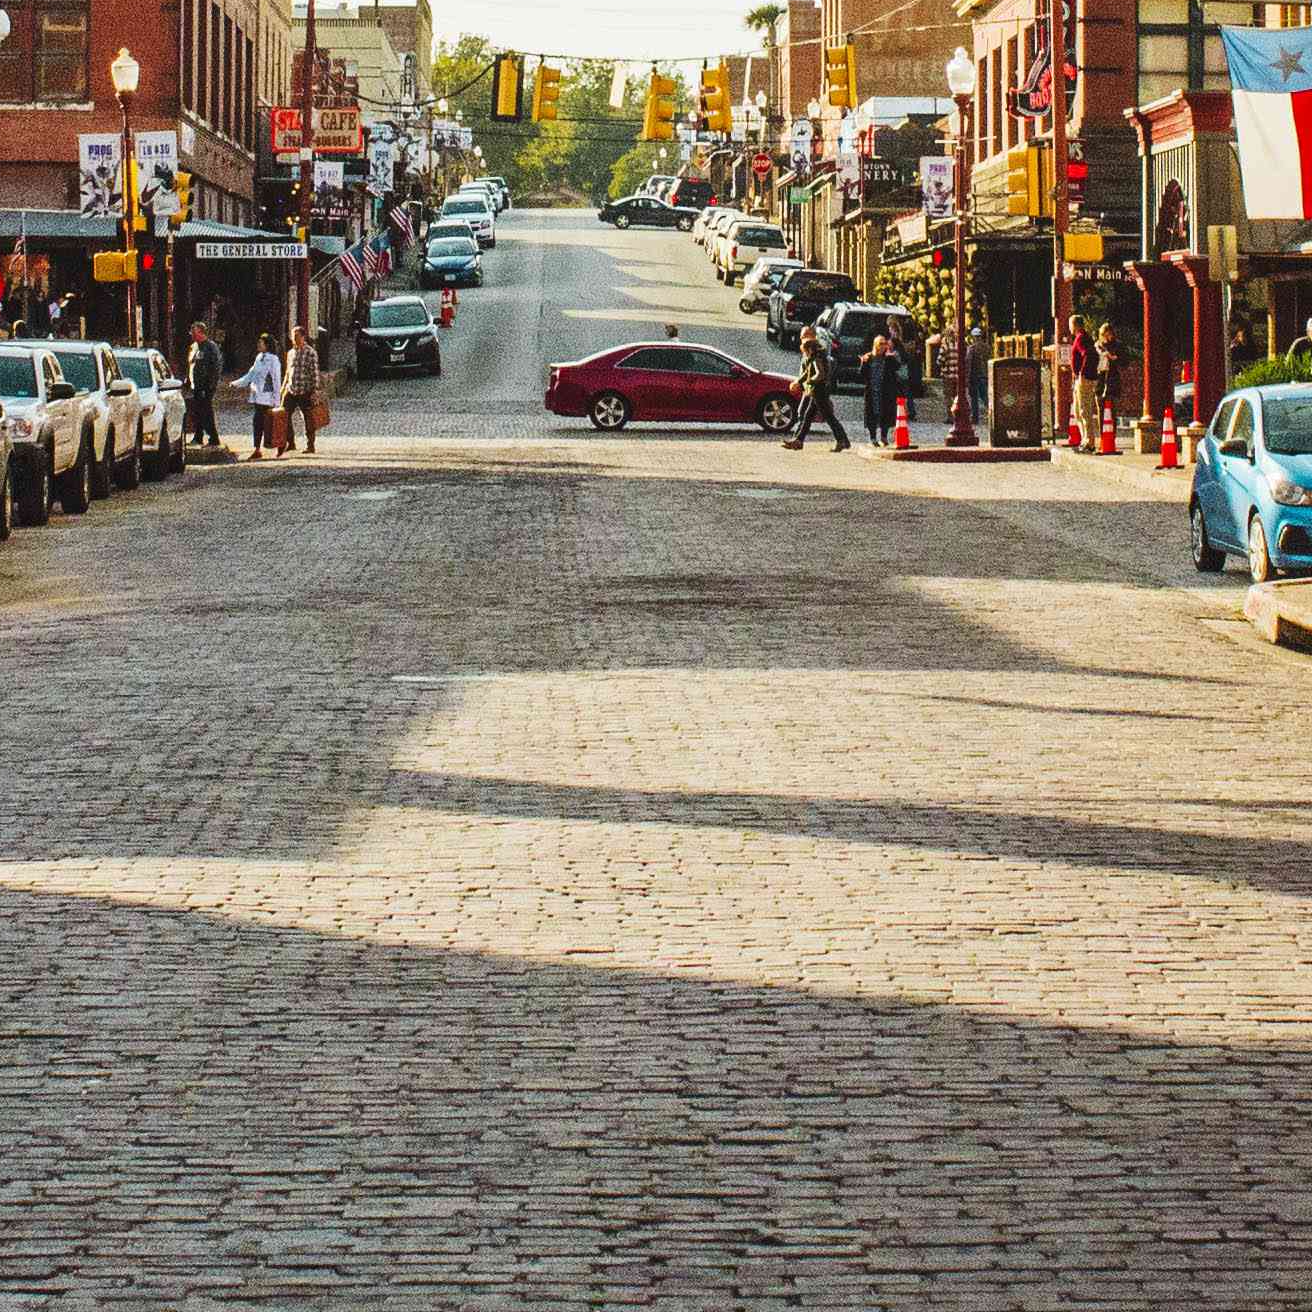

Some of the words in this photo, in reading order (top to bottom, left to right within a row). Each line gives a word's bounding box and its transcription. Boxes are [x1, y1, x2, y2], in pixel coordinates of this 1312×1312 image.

[321, 111, 357, 130] CAFE
[753, 158, 770, 169] STOP
[329, 207, 350, 216] Main
[199, 244, 219, 257] THE
[222, 244, 268, 257] GENERAL
[271, 244, 304, 257] STORE
[1084, 269, 1092, 280] N
[1096, 269, 1122, 280] Main
